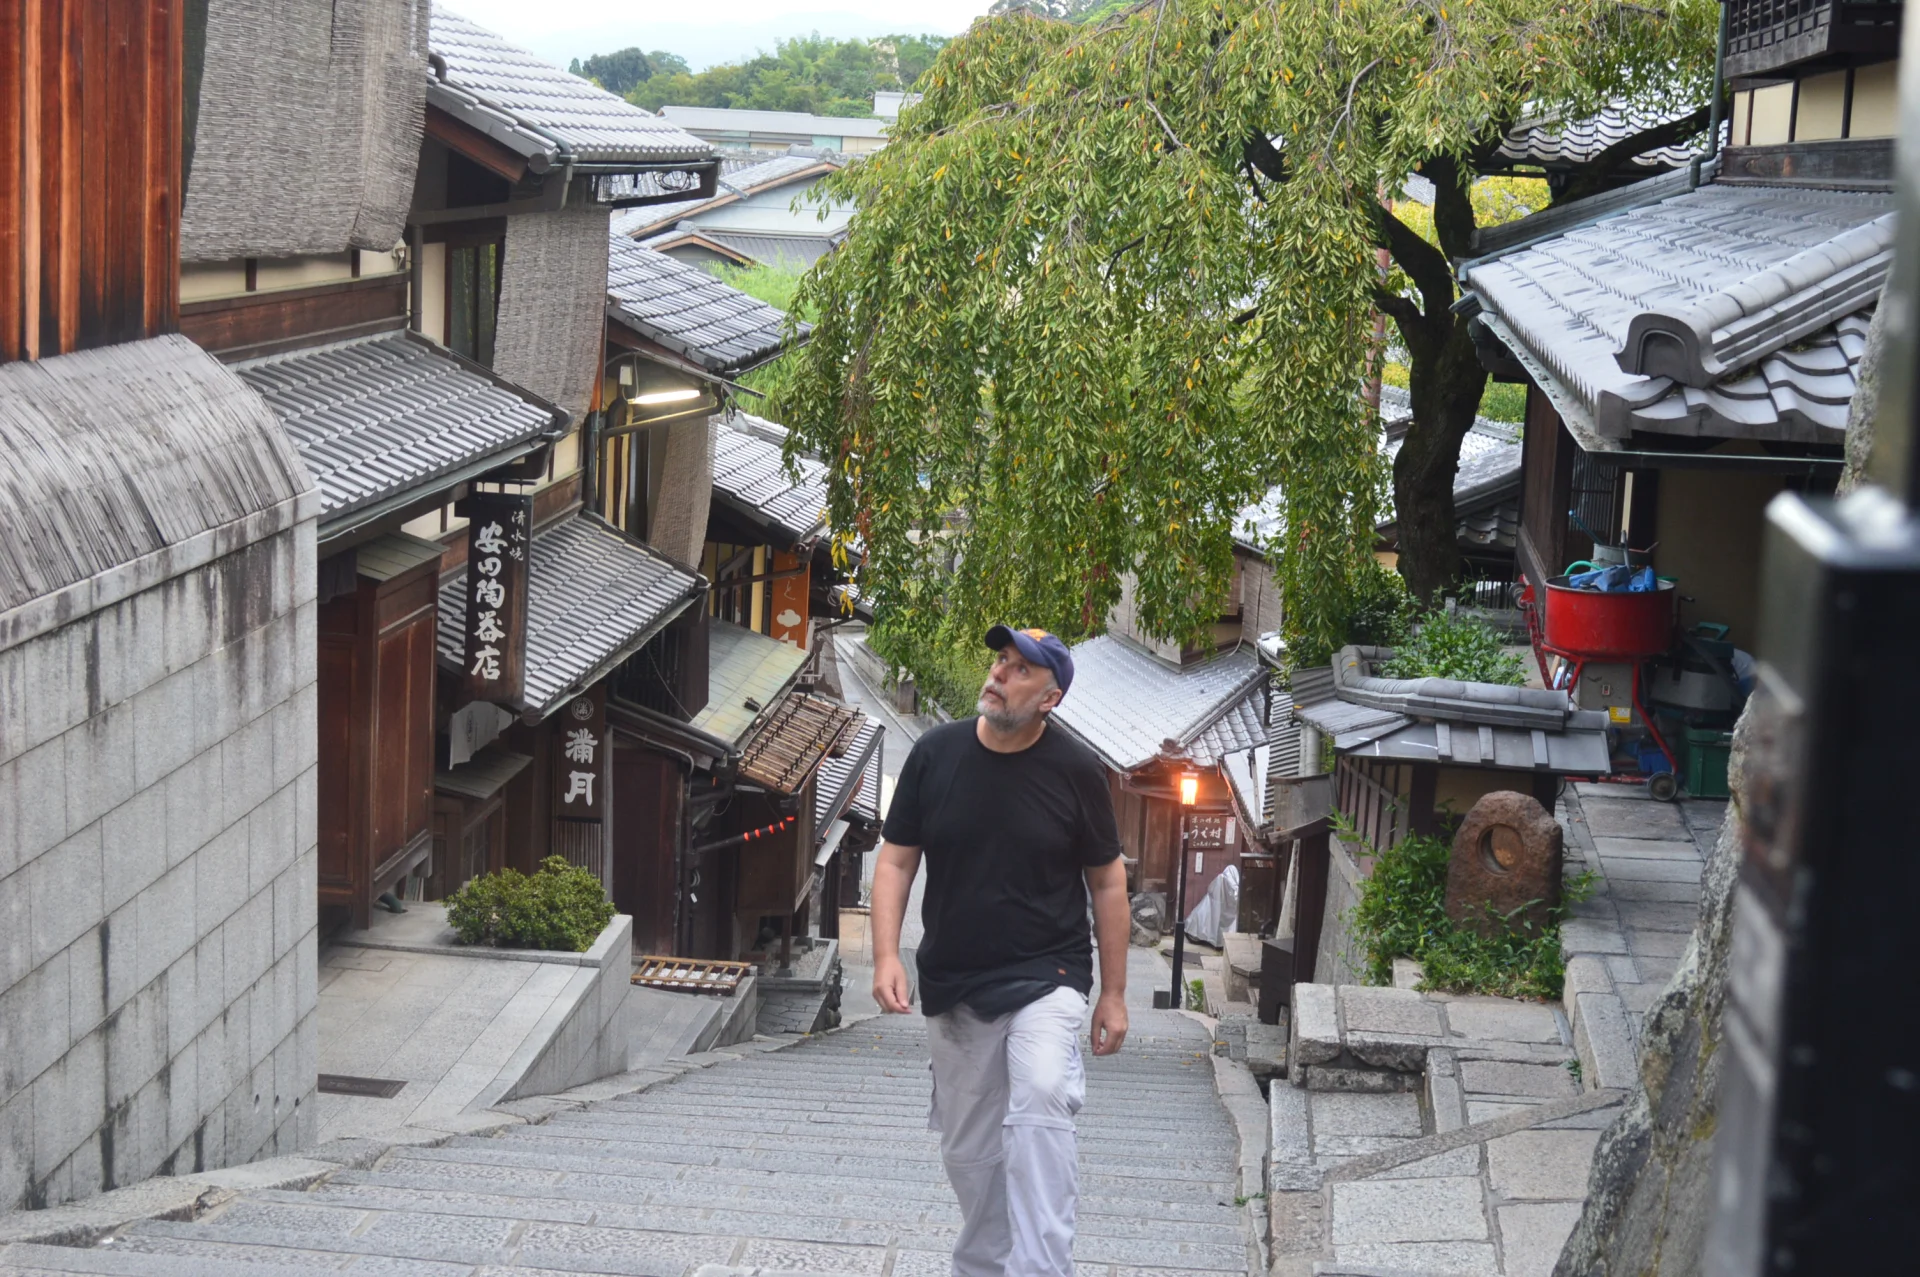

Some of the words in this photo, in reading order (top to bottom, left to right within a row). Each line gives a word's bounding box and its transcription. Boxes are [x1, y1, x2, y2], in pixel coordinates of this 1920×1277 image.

[509, 510, 527, 561] 清水焼
[471, 521, 508, 680] 安田陶器店
[564, 728, 598, 806] 満月
